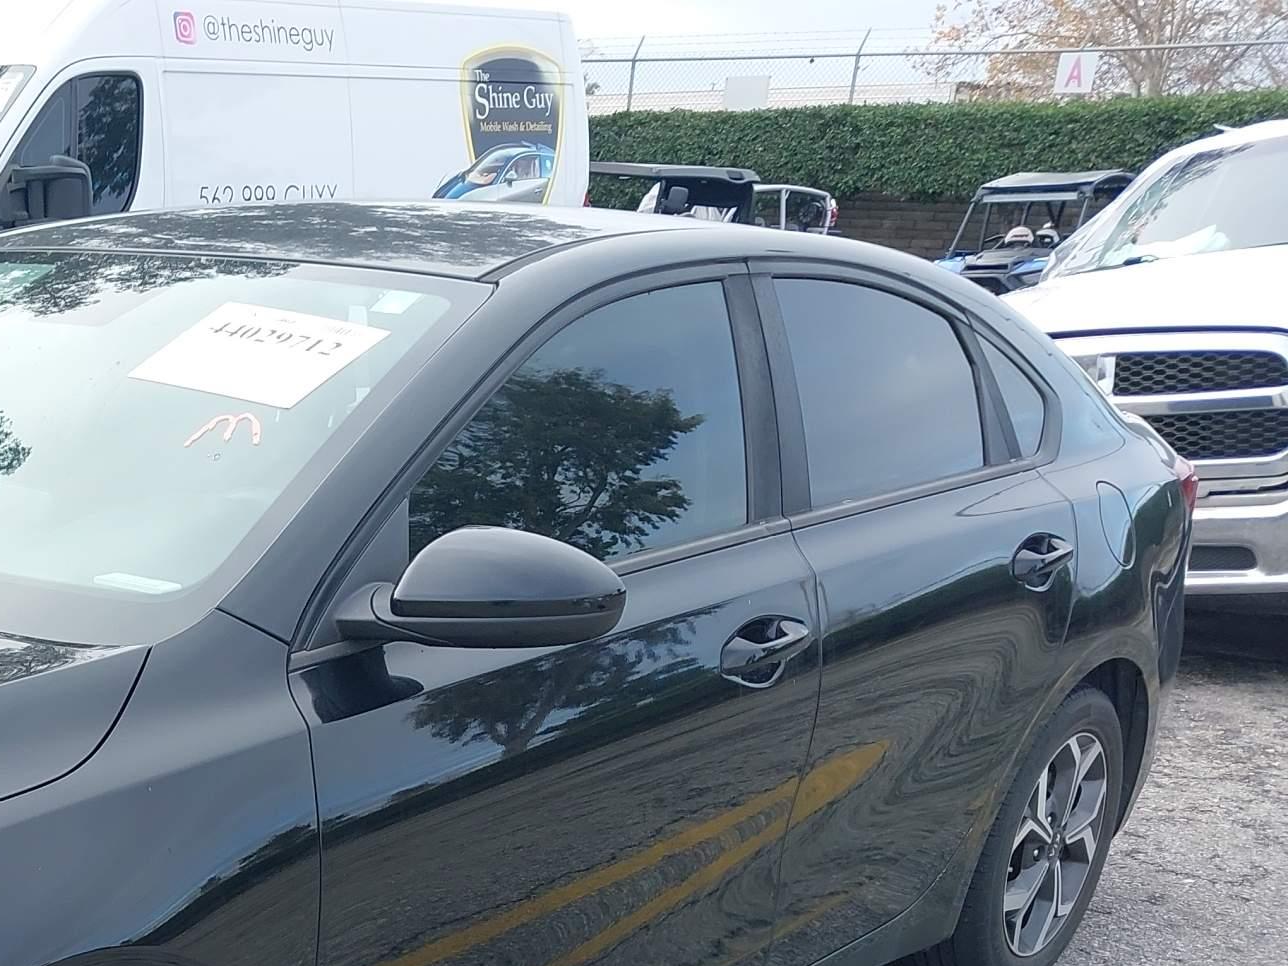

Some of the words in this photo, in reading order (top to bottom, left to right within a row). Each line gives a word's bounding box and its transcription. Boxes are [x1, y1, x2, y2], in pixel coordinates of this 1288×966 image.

[203, 15, 334, 52] @theshineguy
[474, 69, 490, 82] The
[1064, 54, 1081, 88] A
[475, 83, 520, 119] Shine
[523, 85, 554, 116] Guy
[480, 121, 501, 132] Mobile
[502, 121, 519, 132] Wash
[525, 121, 553, 135] Detailing
